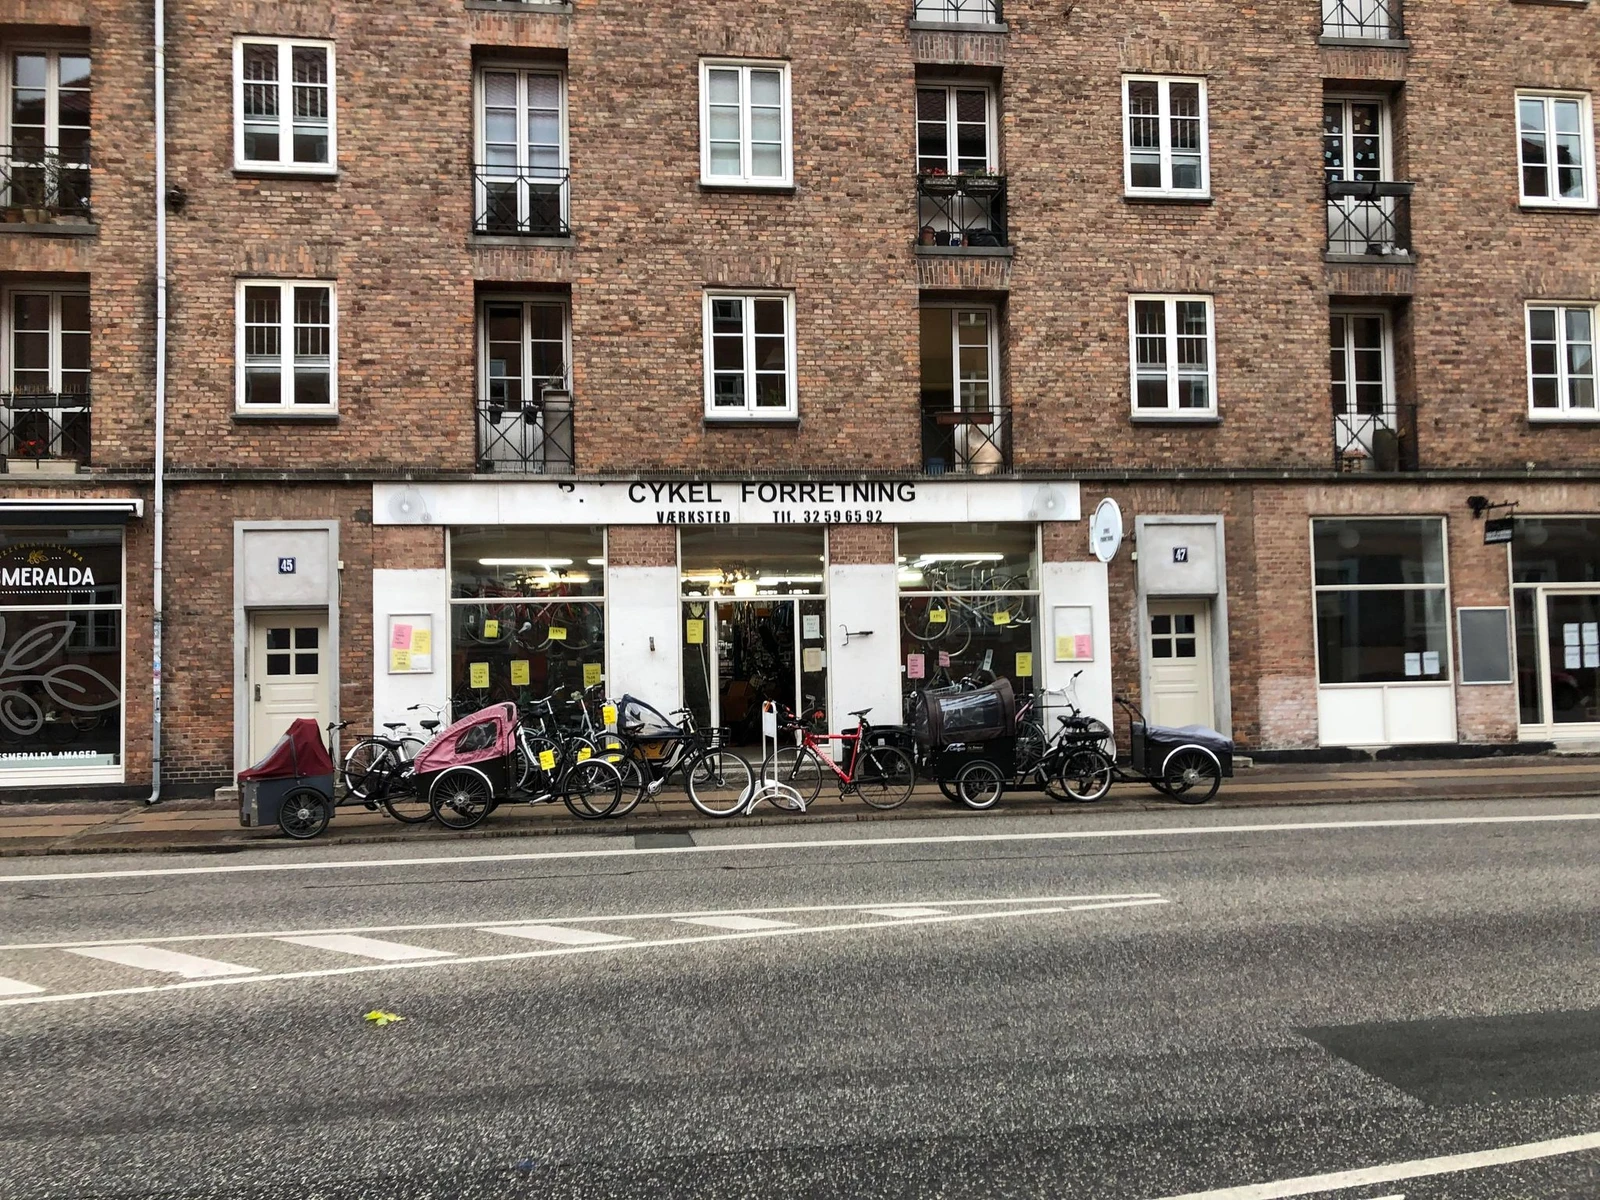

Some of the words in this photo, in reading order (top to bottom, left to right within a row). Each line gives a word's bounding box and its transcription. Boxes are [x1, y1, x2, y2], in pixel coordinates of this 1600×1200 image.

[628, 482, 722, 503] CYKEL
[741, 481, 916, 503] FORRETNING
[656, 510, 731, 523] VÆRKSTED
[1175, 548, 1187, 561] 47
[280, 559, 293, 572] 45
[0, 567, 95, 586] MERALDA
[57, 750, 98, 760] AMAGER
